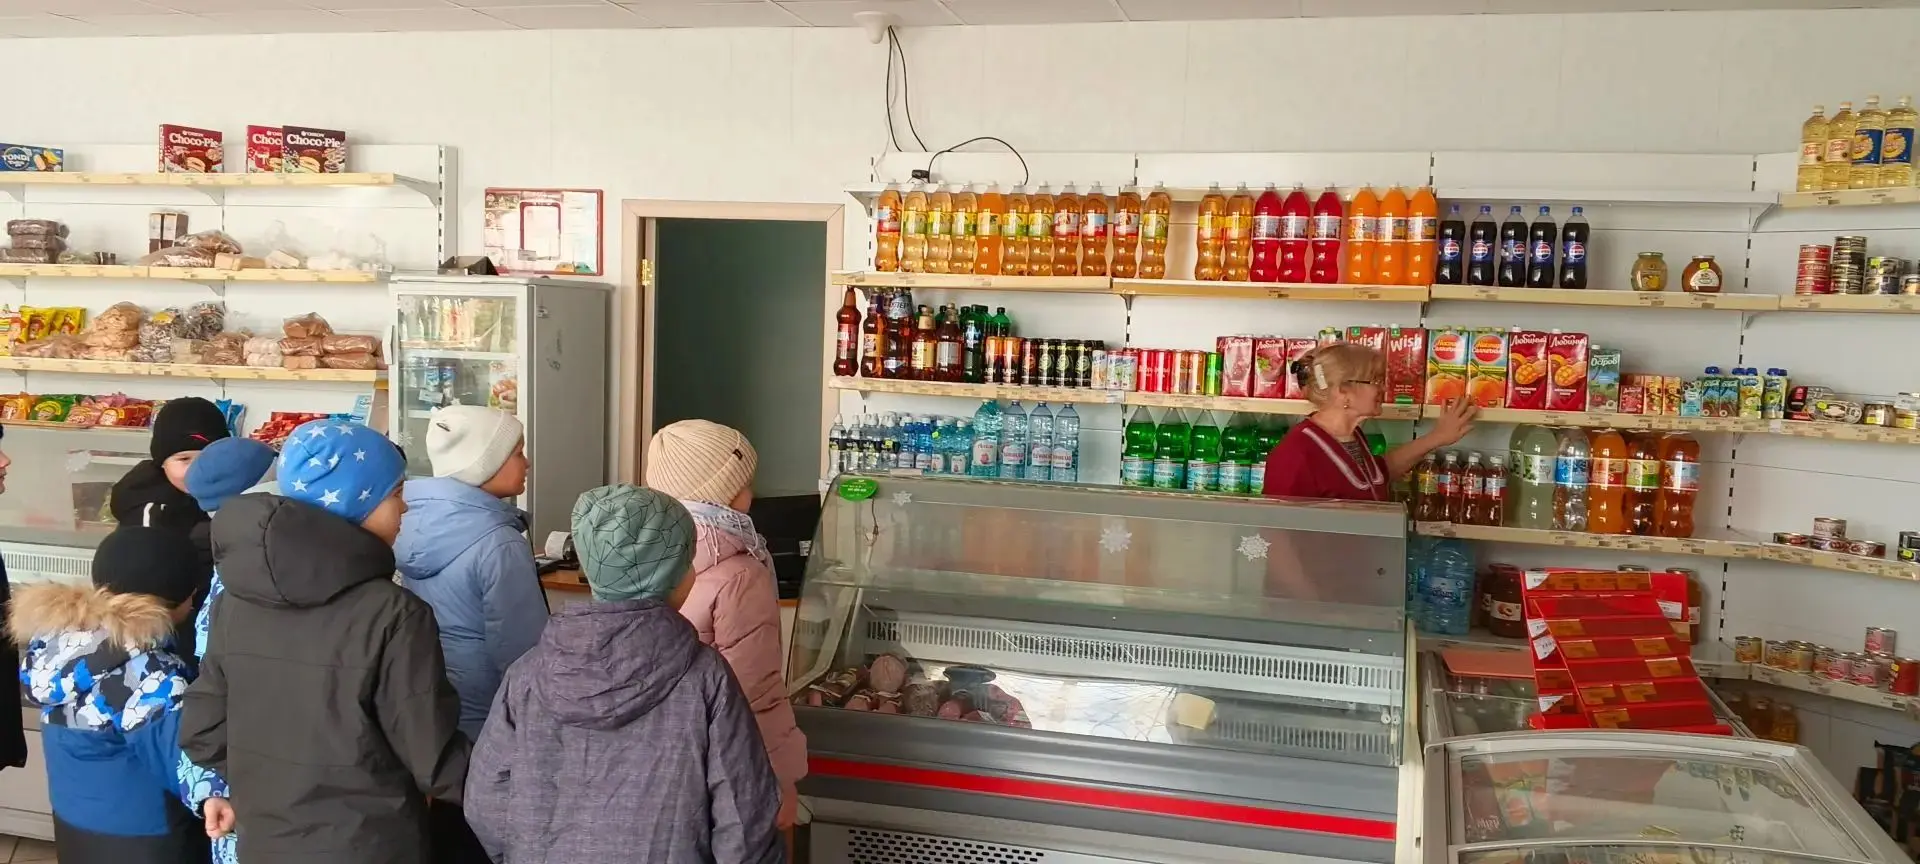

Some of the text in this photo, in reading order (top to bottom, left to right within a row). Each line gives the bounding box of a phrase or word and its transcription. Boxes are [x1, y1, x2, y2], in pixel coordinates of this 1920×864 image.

[2, 153, 30, 161] TONDI
[1510, 334, 1547, 346] Любимый
[1550, 335, 1588, 348] Любимый
